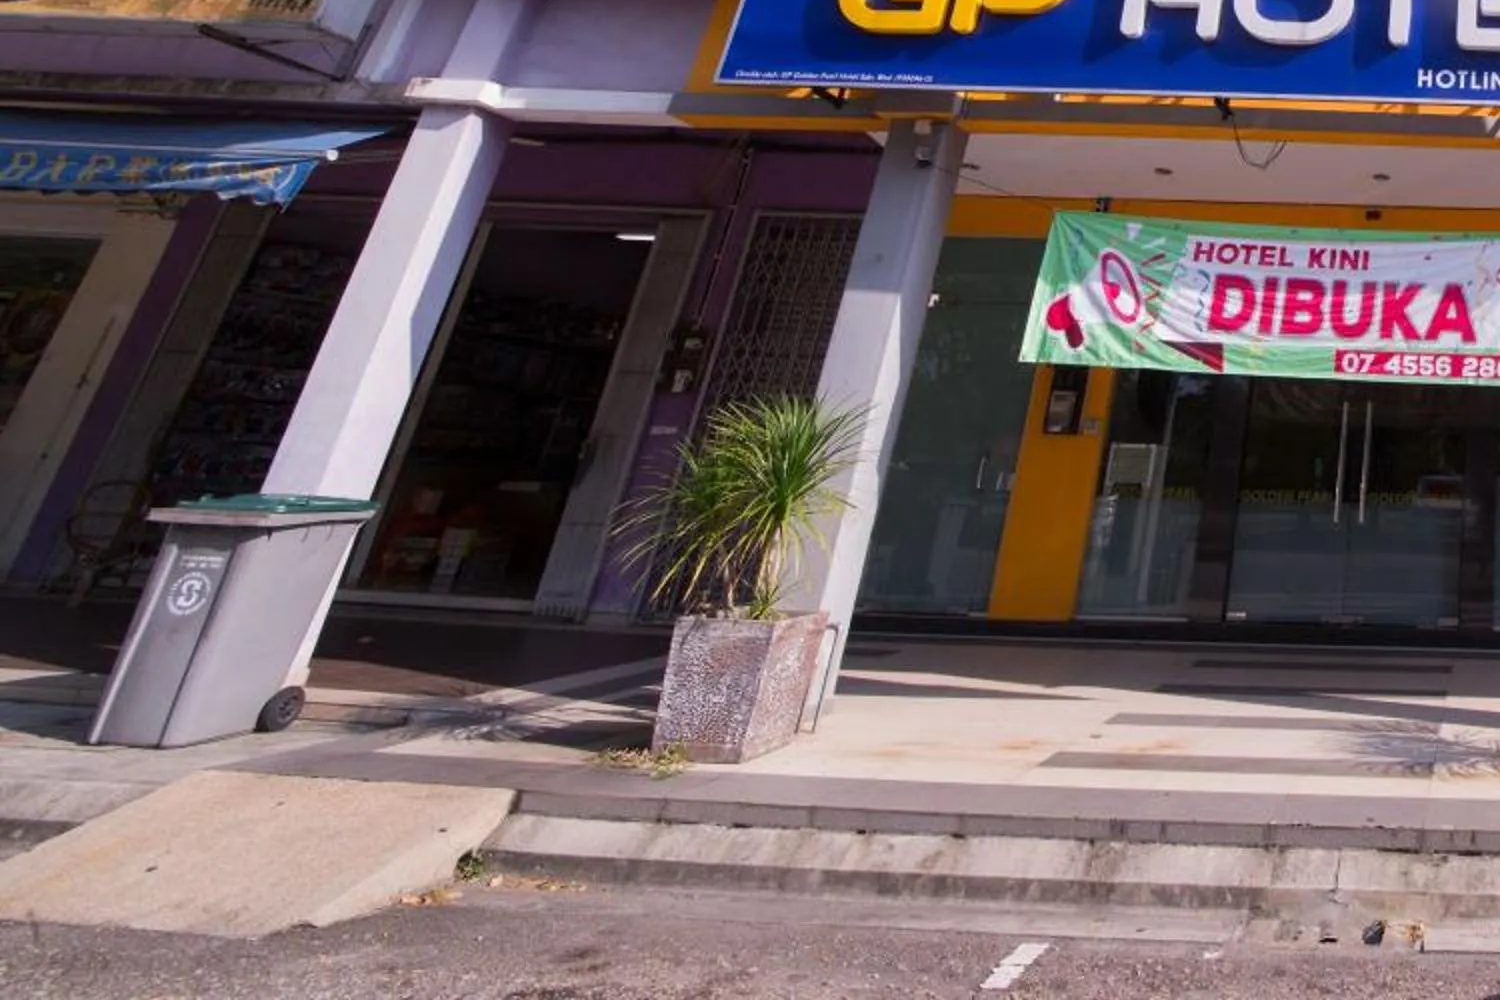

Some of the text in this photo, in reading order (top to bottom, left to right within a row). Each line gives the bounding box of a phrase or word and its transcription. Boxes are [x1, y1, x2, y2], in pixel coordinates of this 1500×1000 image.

[1193, 241, 1371, 271] HOTEL KINI
[1205, 271, 1477, 344] DIBUKA
[1341, 351, 1373, 374] 07
[1383, 353, 1450, 377] 4556
